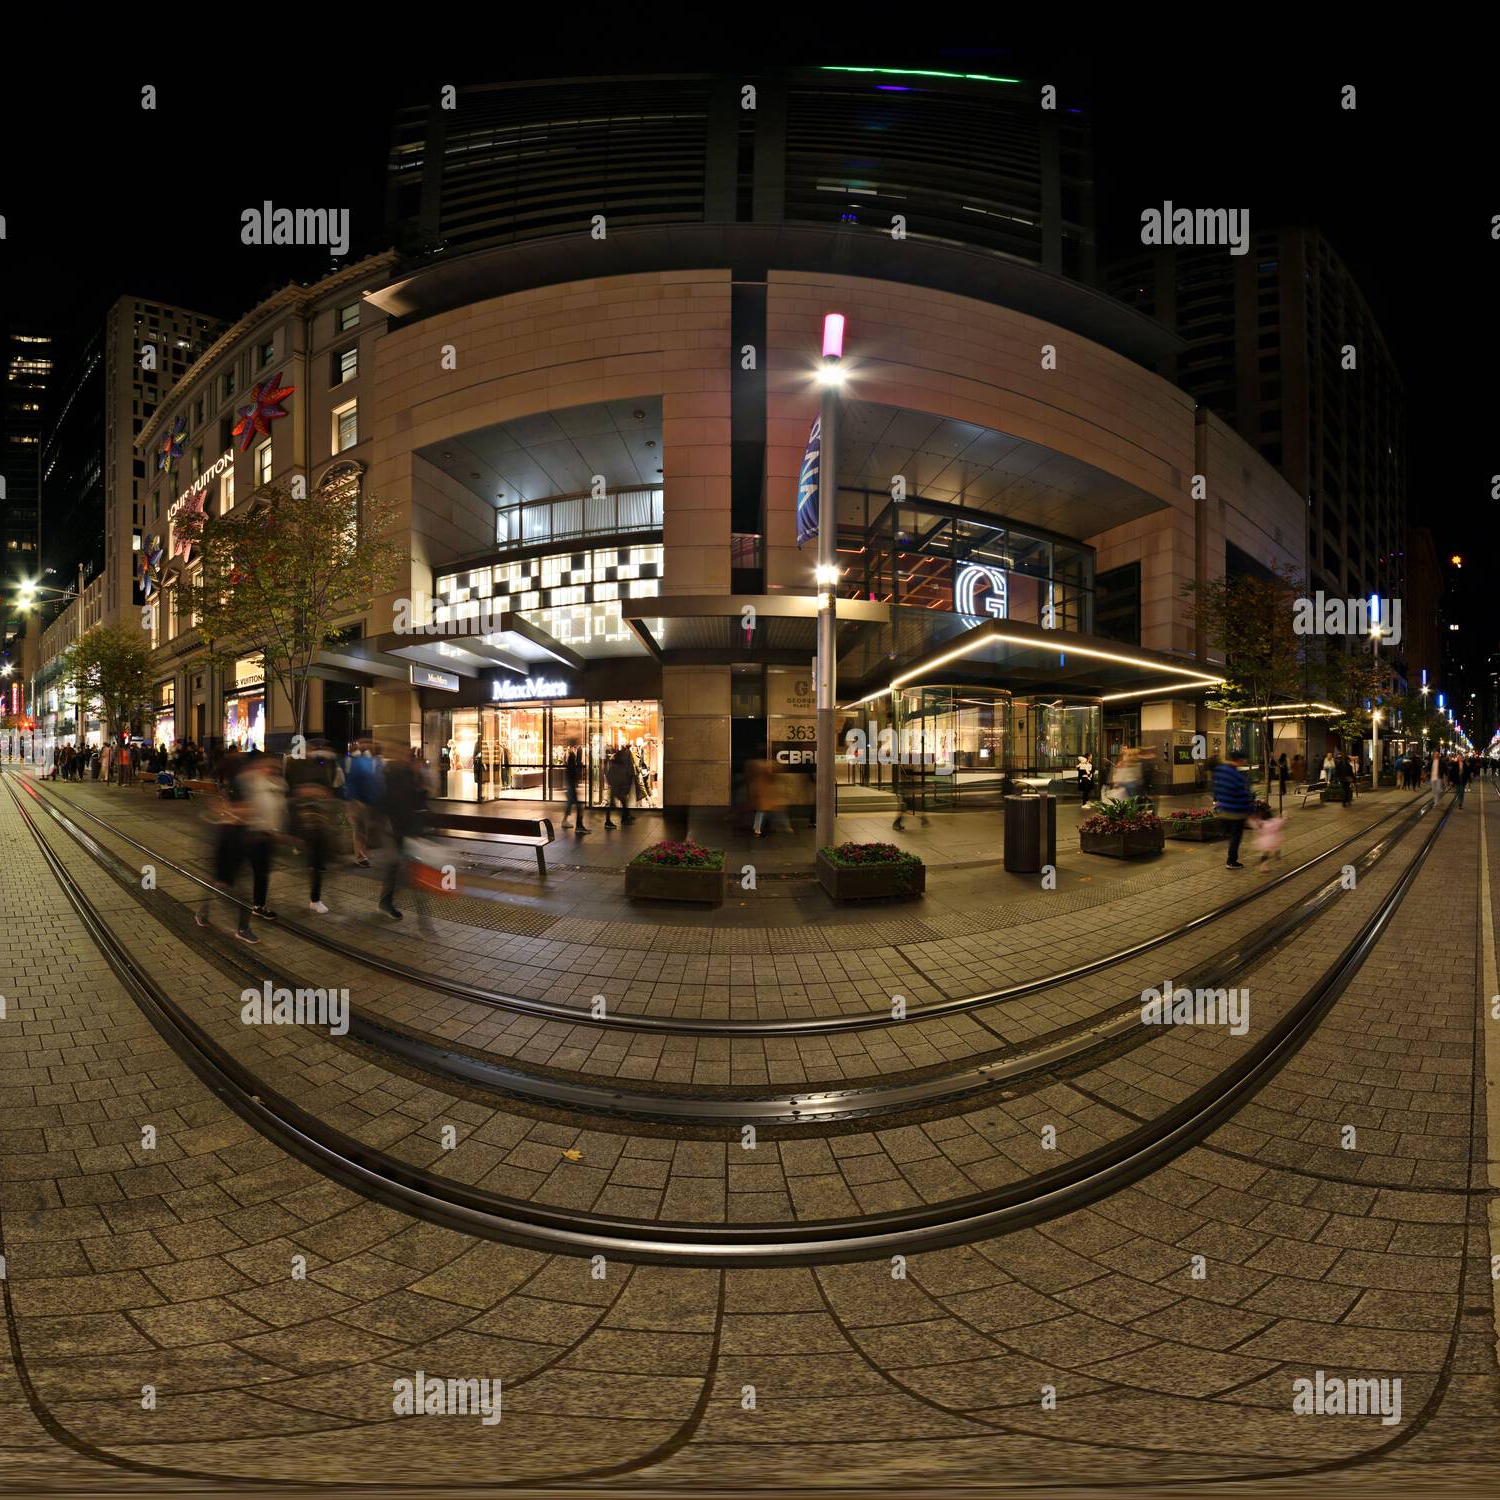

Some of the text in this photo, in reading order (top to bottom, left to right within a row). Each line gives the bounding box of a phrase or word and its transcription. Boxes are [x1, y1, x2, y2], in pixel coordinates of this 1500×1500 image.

[191, 449, 234, 496] VUITTON
[492, 677, 568, 700] MaxMara
[786, 725, 816, 740] 363
[776, 750, 817, 764] CBR
